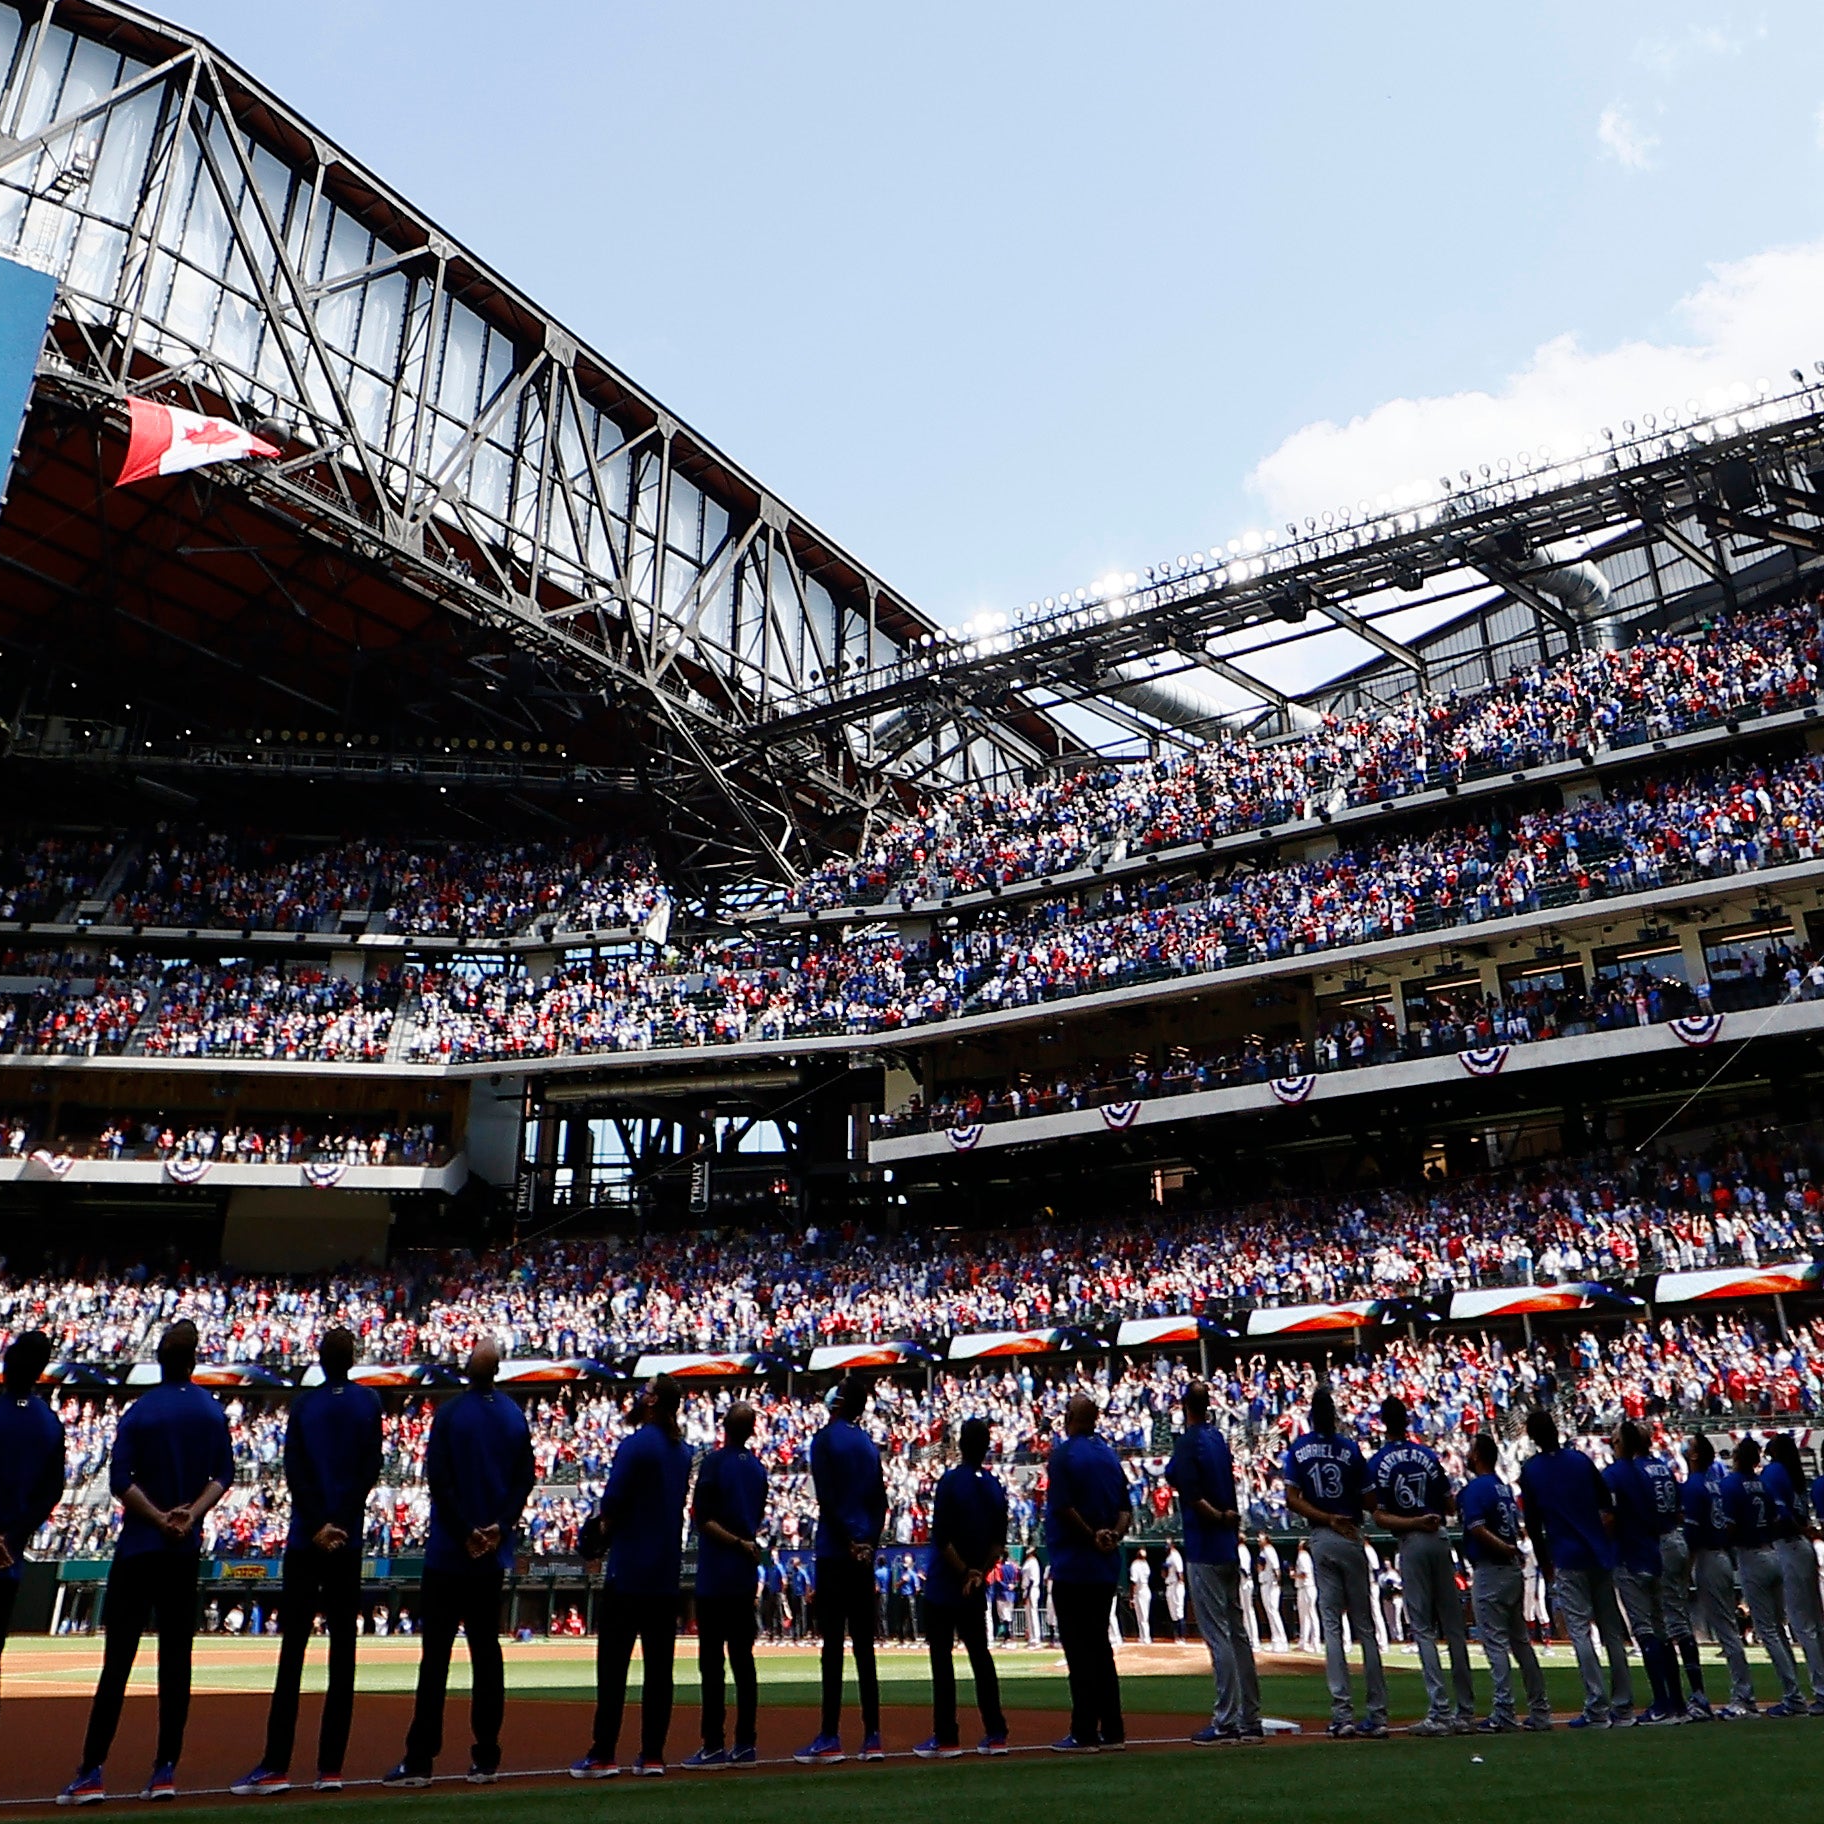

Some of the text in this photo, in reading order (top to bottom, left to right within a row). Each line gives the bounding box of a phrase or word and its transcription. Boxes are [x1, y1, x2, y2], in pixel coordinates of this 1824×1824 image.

[516, 1172, 530, 1212] TRULY
[690, 1162, 703, 1203] TRULY
[1307, 1462, 1343, 1498] 13
[1394, 1472, 1427, 1508] 67
